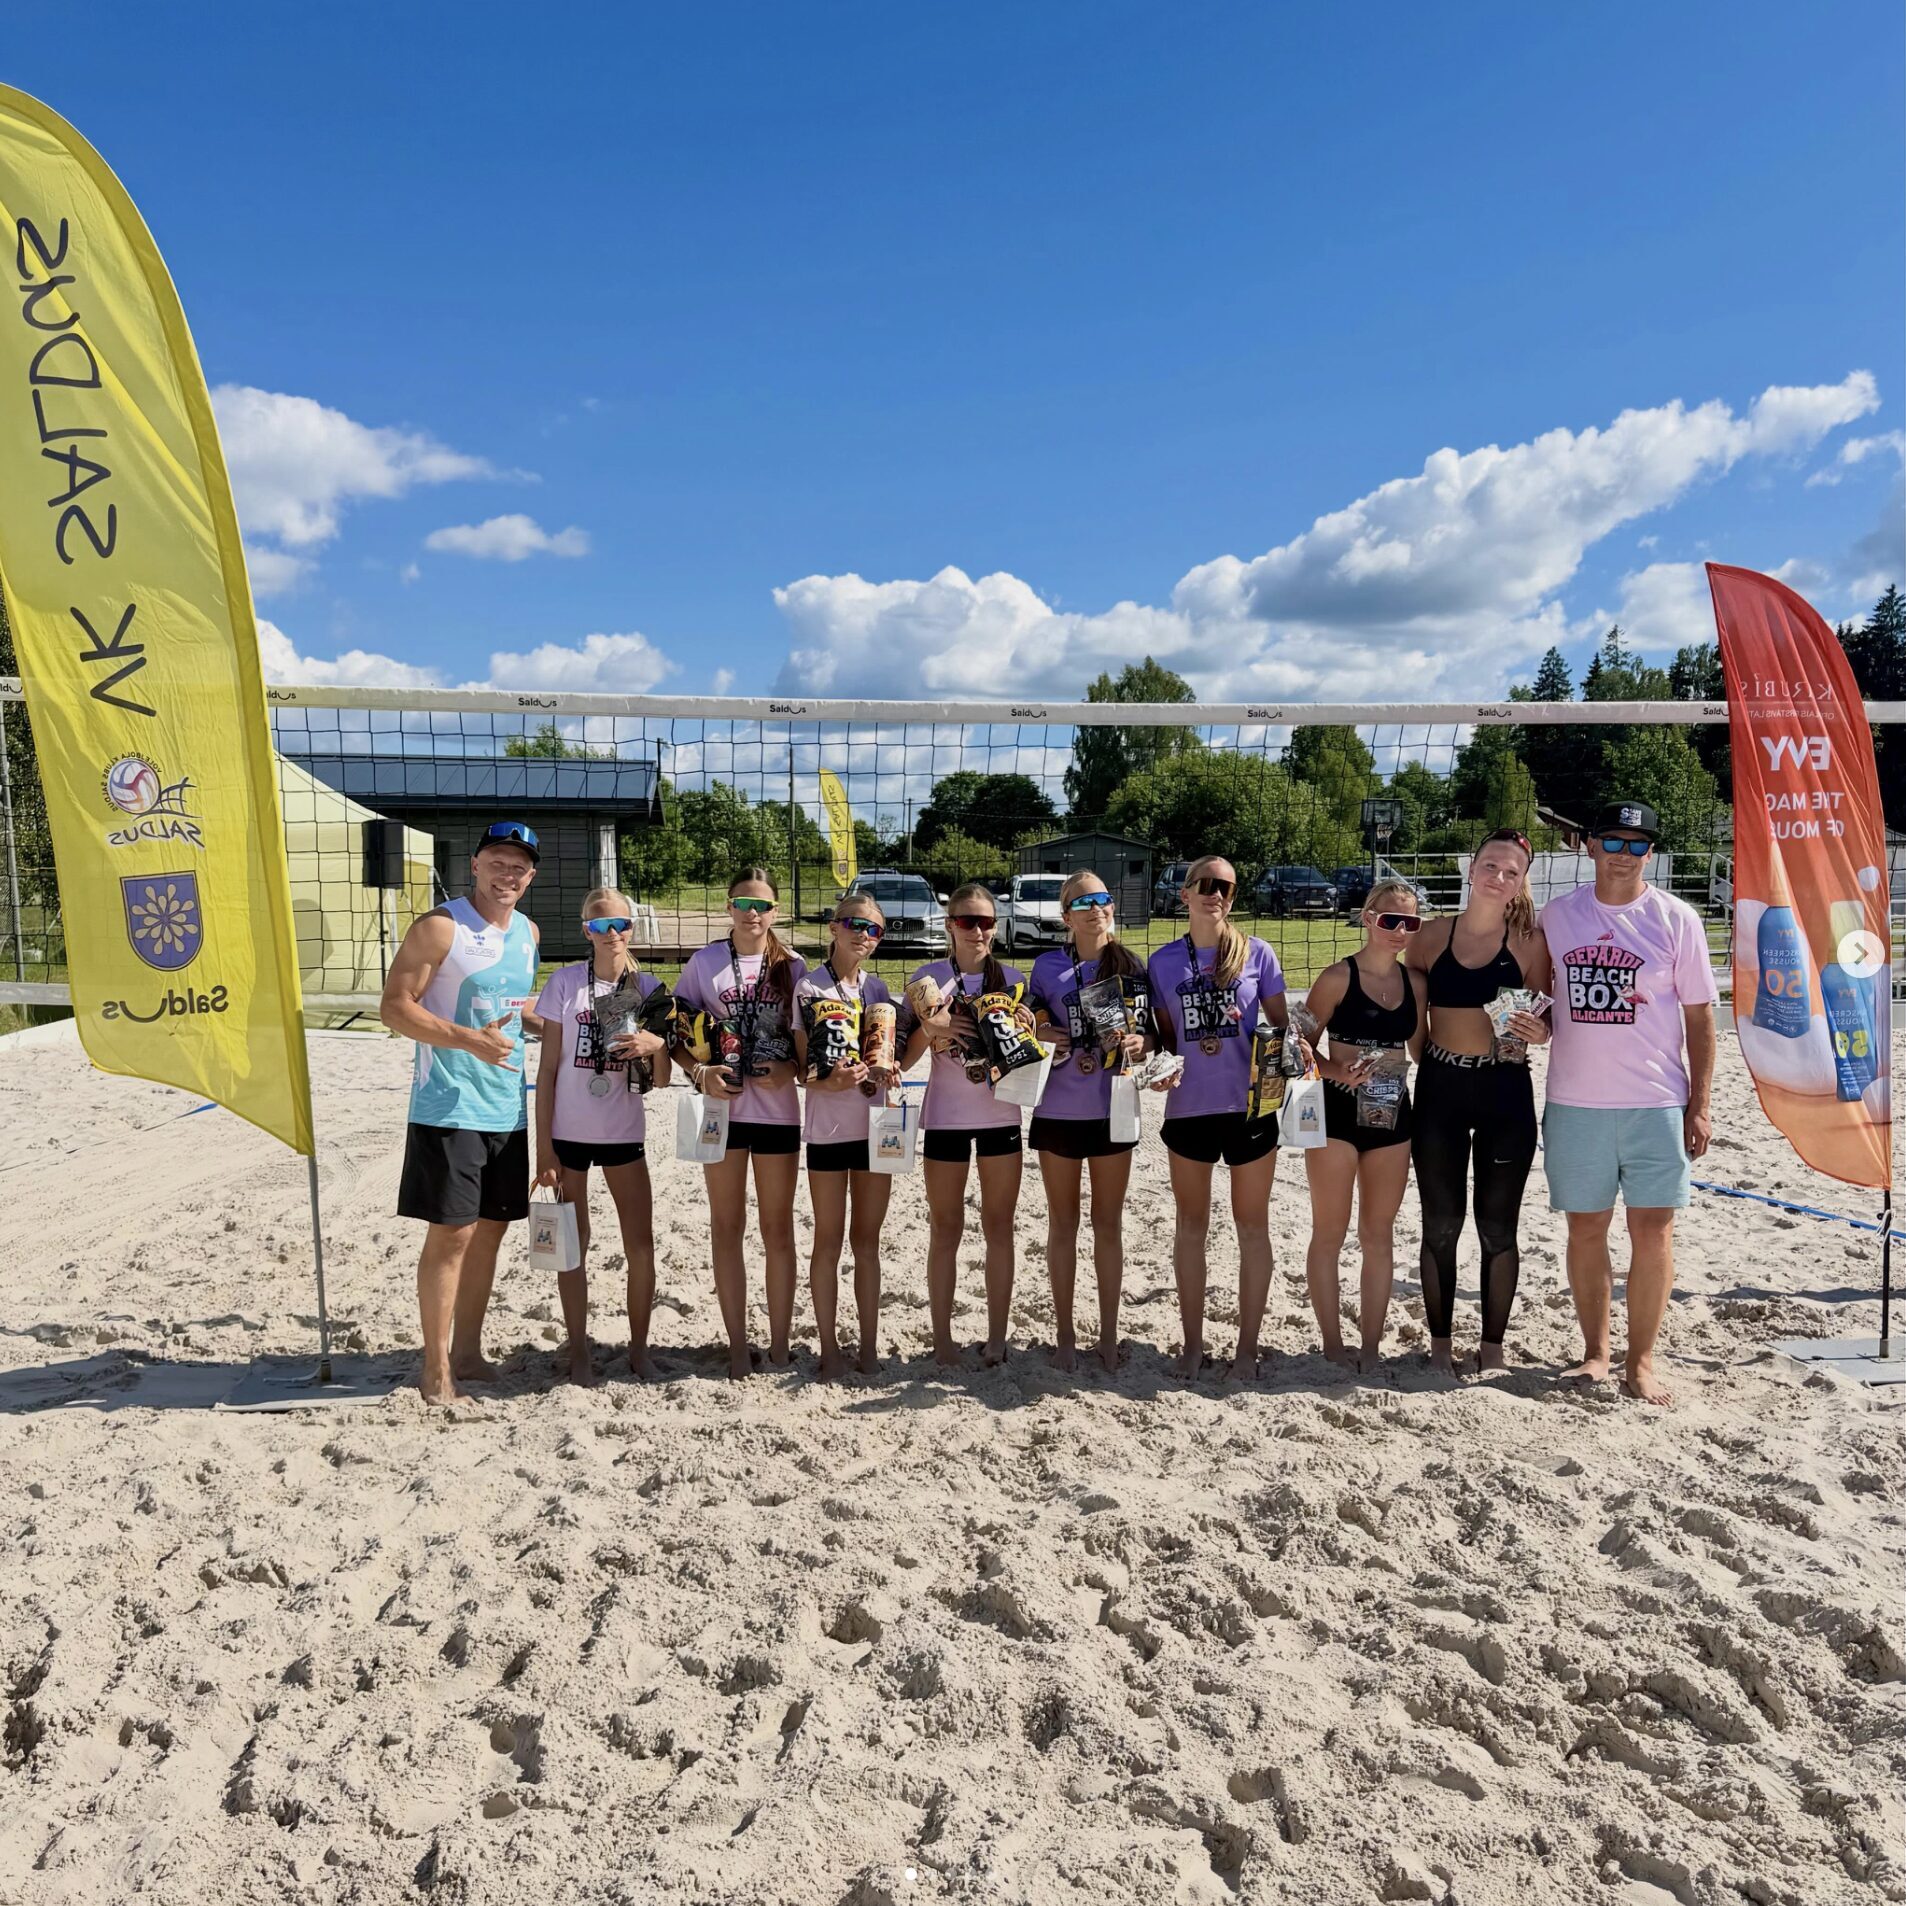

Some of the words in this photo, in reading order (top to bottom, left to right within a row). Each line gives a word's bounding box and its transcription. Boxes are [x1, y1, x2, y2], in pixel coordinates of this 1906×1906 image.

[518, 697, 557, 708] Saldus
[770, 704, 807, 715] Saldus
[1011, 708, 1047, 719] Saldus
[1247, 709, 1283, 719] Saldus
[1477, 708, 1512, 718] Saldus
[1563, 945, 1645, 969] GEPARDI
[1569, 966, 1634, 985] BEACH
[1569, 983, 1633, 1010] BOX
[1572, 1009, 1633, 1023] ALICANTE
